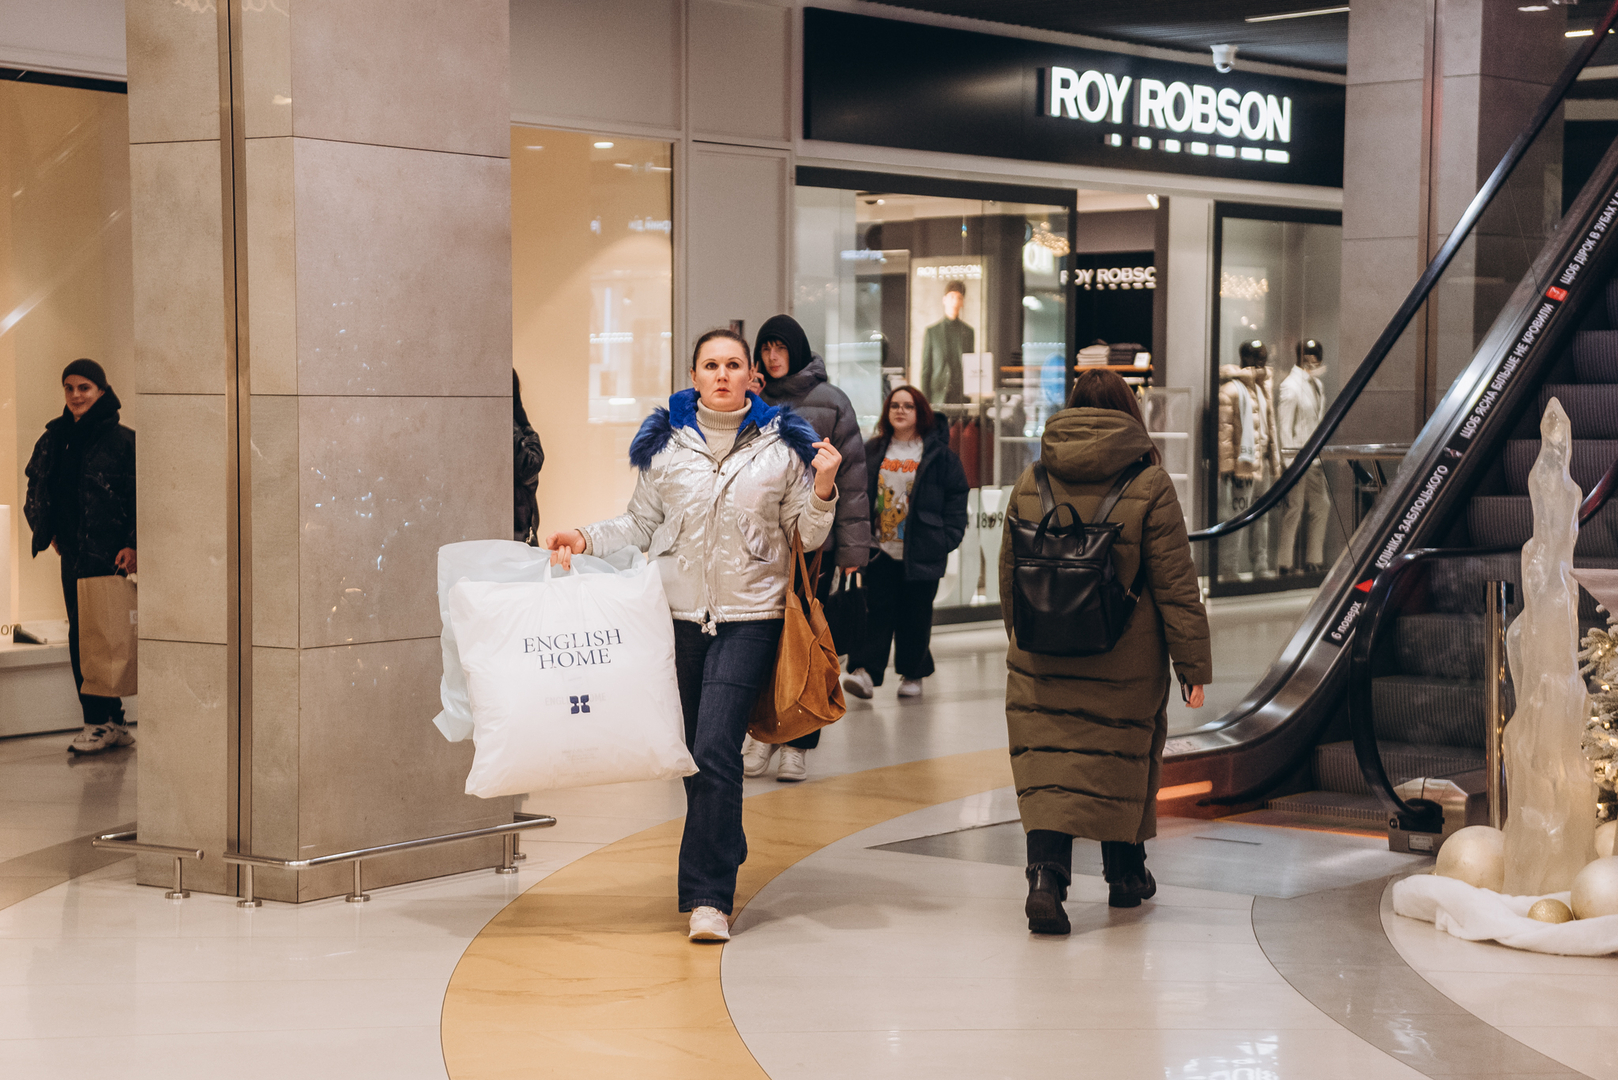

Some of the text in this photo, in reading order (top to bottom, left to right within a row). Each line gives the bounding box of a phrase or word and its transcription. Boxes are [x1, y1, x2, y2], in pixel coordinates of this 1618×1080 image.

[1048, 66, 1292, 143] ROY ROBSON
[1593, 204, 1617, 233] ЗУБАХ
[1588, 231, 1601, 241] В
[1573, 238, 1597, 266] ДІРОК
[917, 264, 982, 277] ROY ROBSON
[1096, 266, 1157, 284] ROBSO
[1559, 262, 1581, 286] ЩОБ
[1460, 302, 1555, 440] ЩОБ ЯСНА БІЛЬШЕ НЕ КРОВИЛИ
[1375, 465, 1449, 569] КЛІНІКА ЗАБЛОЦЬКОГО
[1331, 601, 1362, 641] 6 поверх
[523, 628, 623, 654] ENGLISH
[538, 648, 612, 670] HOME
